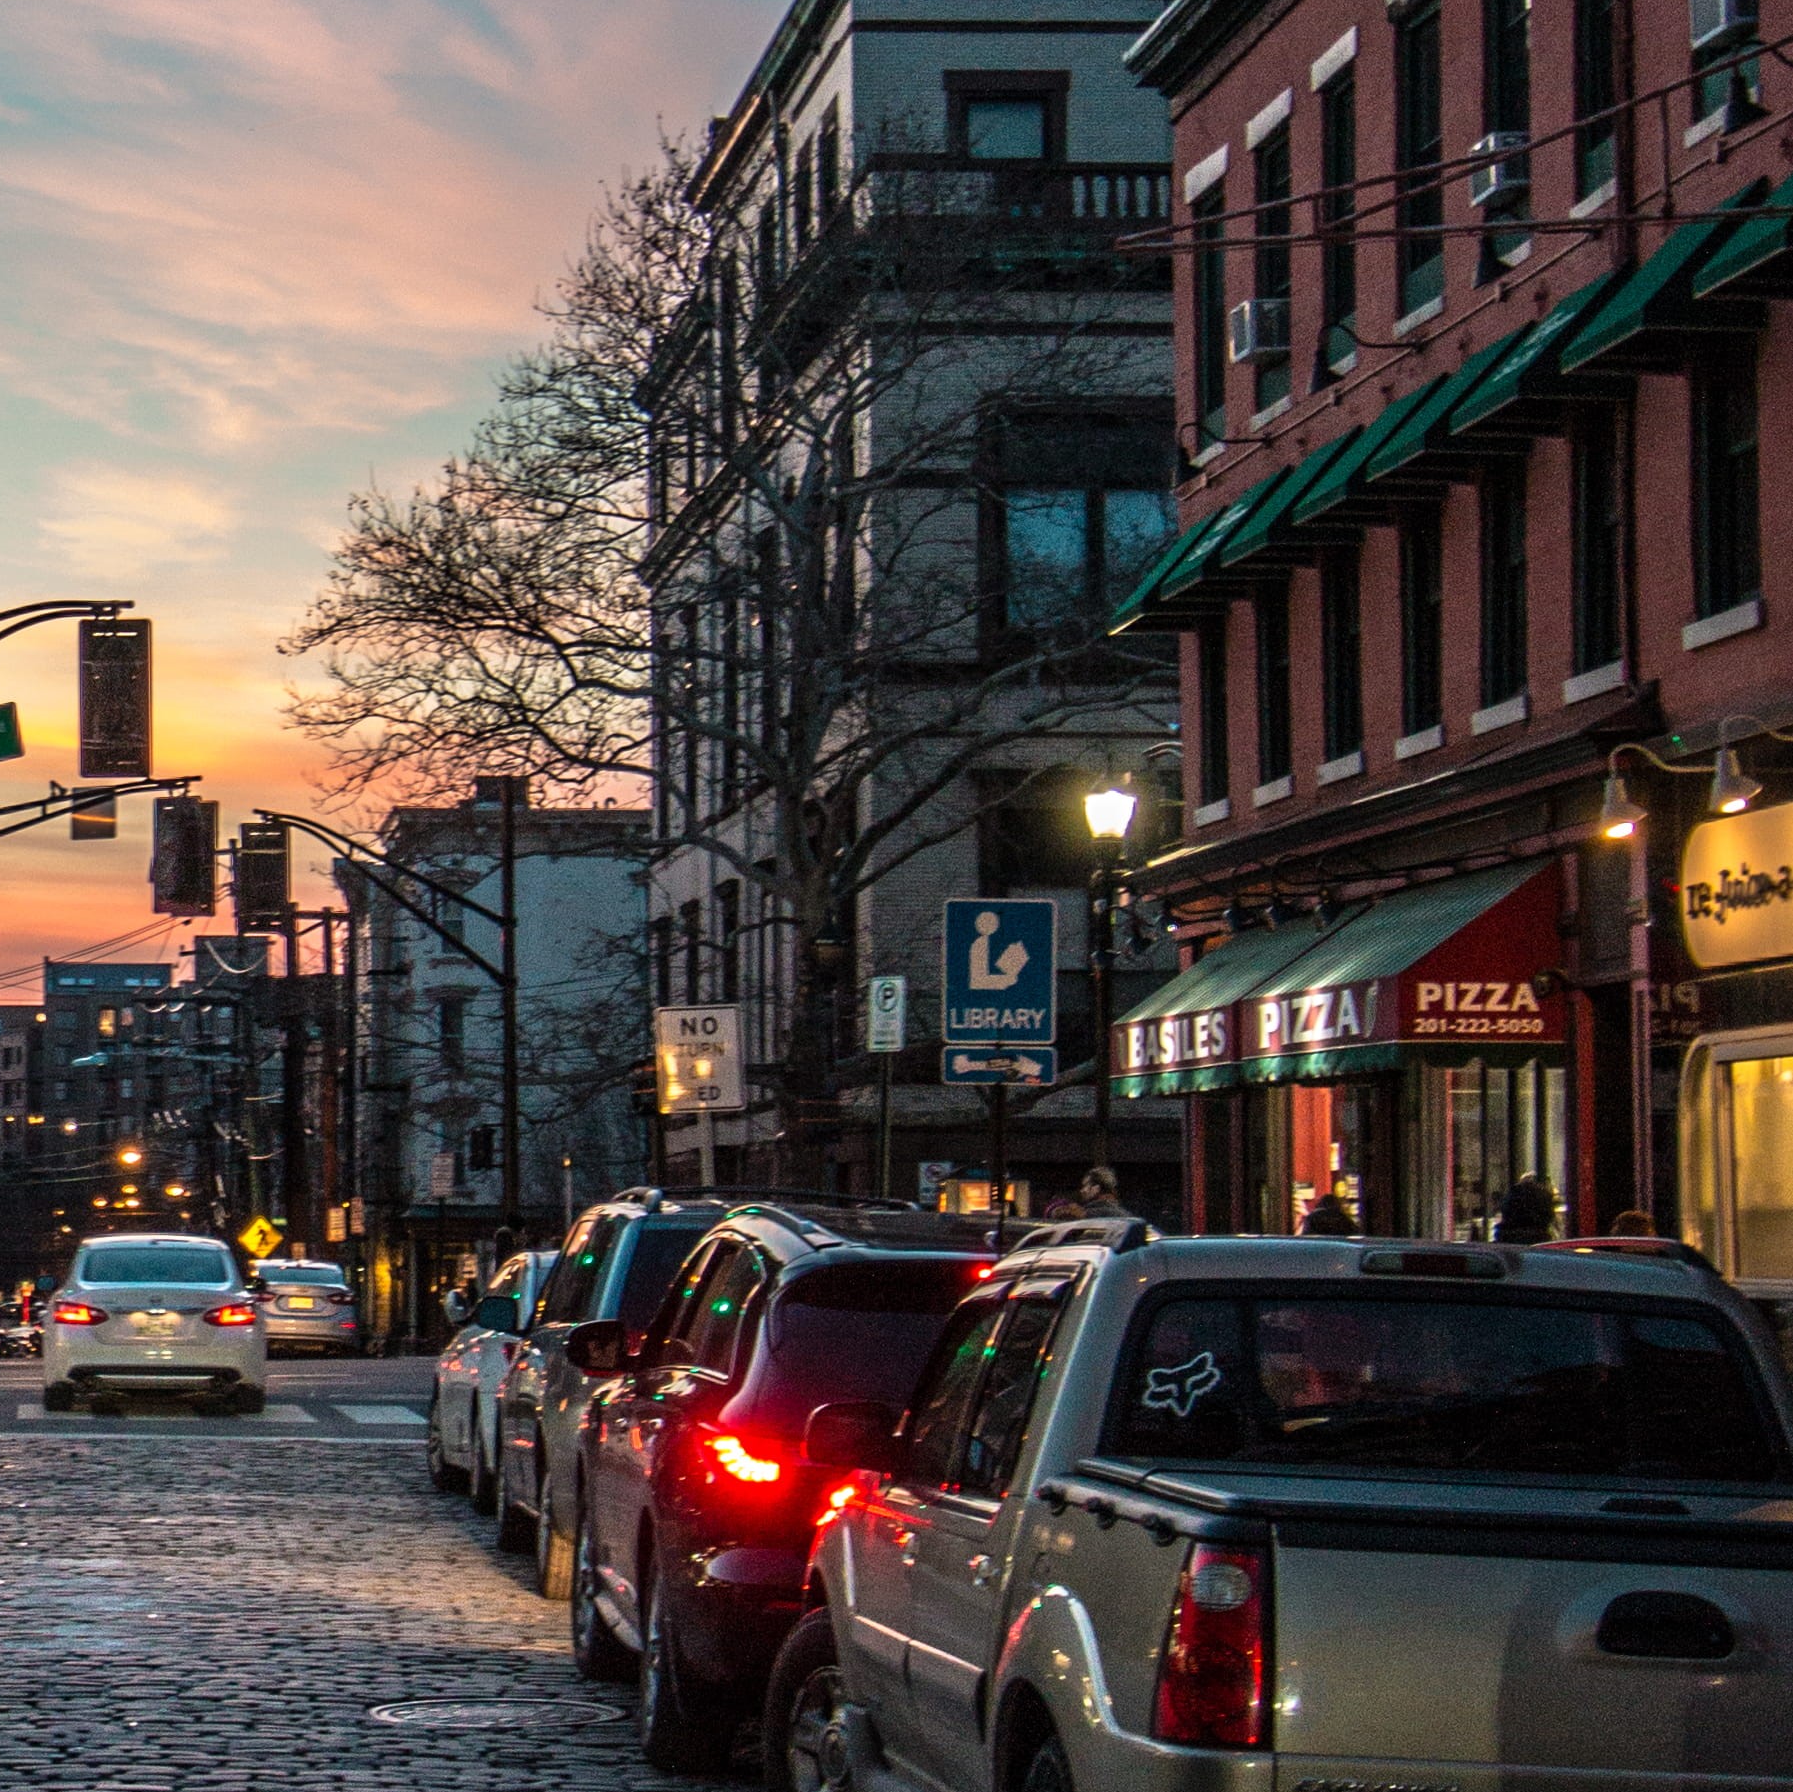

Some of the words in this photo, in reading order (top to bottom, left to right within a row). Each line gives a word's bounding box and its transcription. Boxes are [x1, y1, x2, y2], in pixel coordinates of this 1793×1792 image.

[1416, 982, 1541, 1012] PIZZA
[680, 1016, 719, 1036] NO
[949, 1008, 1046, 1029] LIBRARY
[1259, 988, 1361, 1050] PIZZA
[1413, 1018, 1545, 1034] 201-222-5050
[676, 1042, 725, 1058] TURN
[686, 1085, 722, 1101] ED
